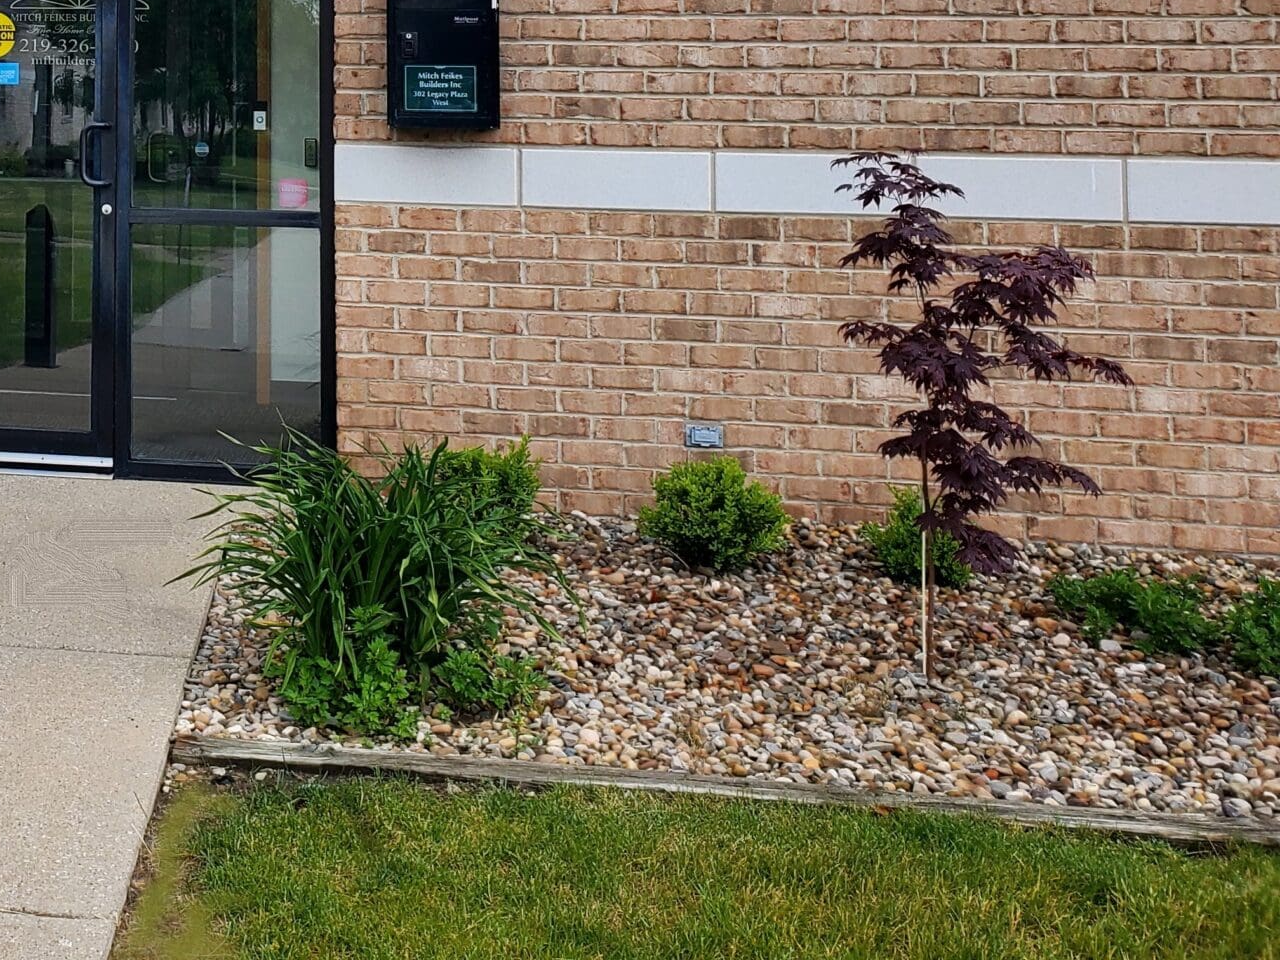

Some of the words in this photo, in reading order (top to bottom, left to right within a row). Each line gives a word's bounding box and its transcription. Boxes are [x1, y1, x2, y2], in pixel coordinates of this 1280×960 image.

[10, 13, 42, 22] MITCH
[44, 13, 78, 22] FEIKES
[31, 54, 96, 66] mfbuilders
[418, 72, 440, 80] Mitch
[440, 72, 463, 80] Feikes
[419, 80, 449, 88] Builders
[450, 80, 463, 88] Inc
[413, 90, 427, 98] 302
[427, 91, 449, 99] Legacy
